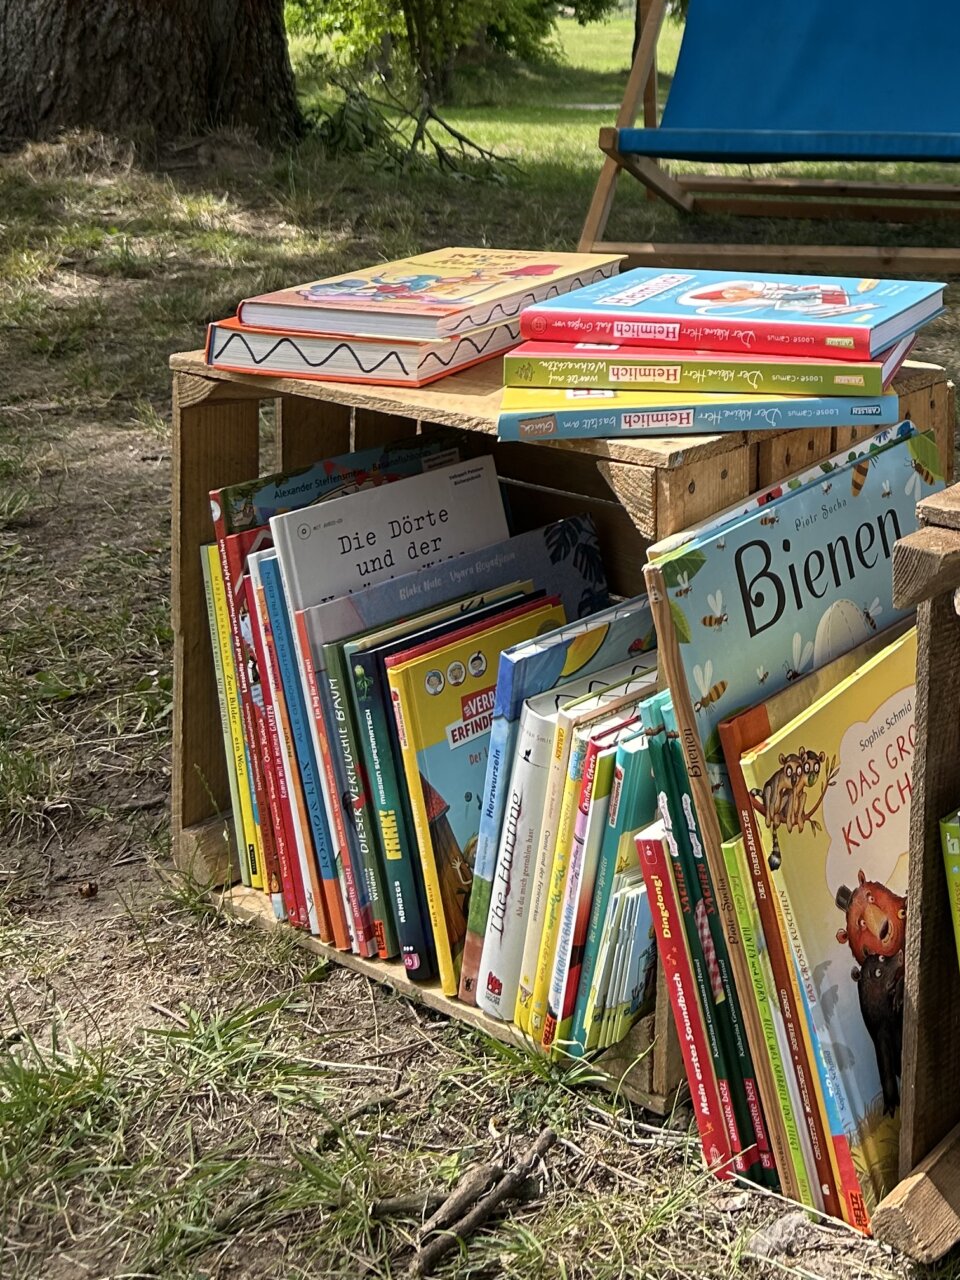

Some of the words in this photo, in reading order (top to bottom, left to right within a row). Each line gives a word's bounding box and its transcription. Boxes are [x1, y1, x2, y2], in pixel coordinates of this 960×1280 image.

[595, 321, 611, 331] hat
[615, 323, 677, 339] Heimlich
[681, 327, 703, 338] Herr
[703, 328, 728, 339] kleine
[731, 328, 756, 347] Der
[611, 366, 677, 380] Heimlich
[683, 369, 706, 381] Herr
[707, 368, 734, 381] kleine
[737, 368, 763, 388] Der
[622, 410, 691, 426] Heimlich
[697, 410, 721, 422] Herr
[723, 407, 752, 421] kleine
[756, 407, 782, 426] Der
[852, 406, 878, 414] CARLSEN
[336, 527, 378, 555] Die
[386, 504, 450, 539] Dörte
[354, 549, 395, 576] und
[404, 533, 444, 560] der
[734, 507, 904, 638] Bienen
[228, 697, 239, 724] Bilder
[327, 677, 345, 722] BAUM
[856, 725, 889, 753] Sophie
[881, 701, 915, 730] Schmid
[679, 727, 702, 779] Bienen
[485, 748, 502, 817] Herzwurzeln
[846, 759, 880, 805] DAS
[352, 806, 370, 853] DIESER
[842, 772, 912, 855] KUSCH
[497, 788, 523, 884] Hurting
[519, 878, 527, 894] mich
[489, 891, 508, 933] The
[650, 873, 673, 938] Dingdong!
[778, 888, 798, 941] KUSCHELN
[793, 942, 809, 980] GROSSE
[672, 972, 694, 1042] Soundbuch
[805, 983, 816, 1002] DAS
[688, 1043, 702, 1081] erstes
[696, 1082, 709, 1115] Mein
[719, 1080, 729, 1102] betz
[744, 1080, 755, 1101] betz
[723, 1103, 737, 1141] annette
[750, 1102, 763, 1139] annette
